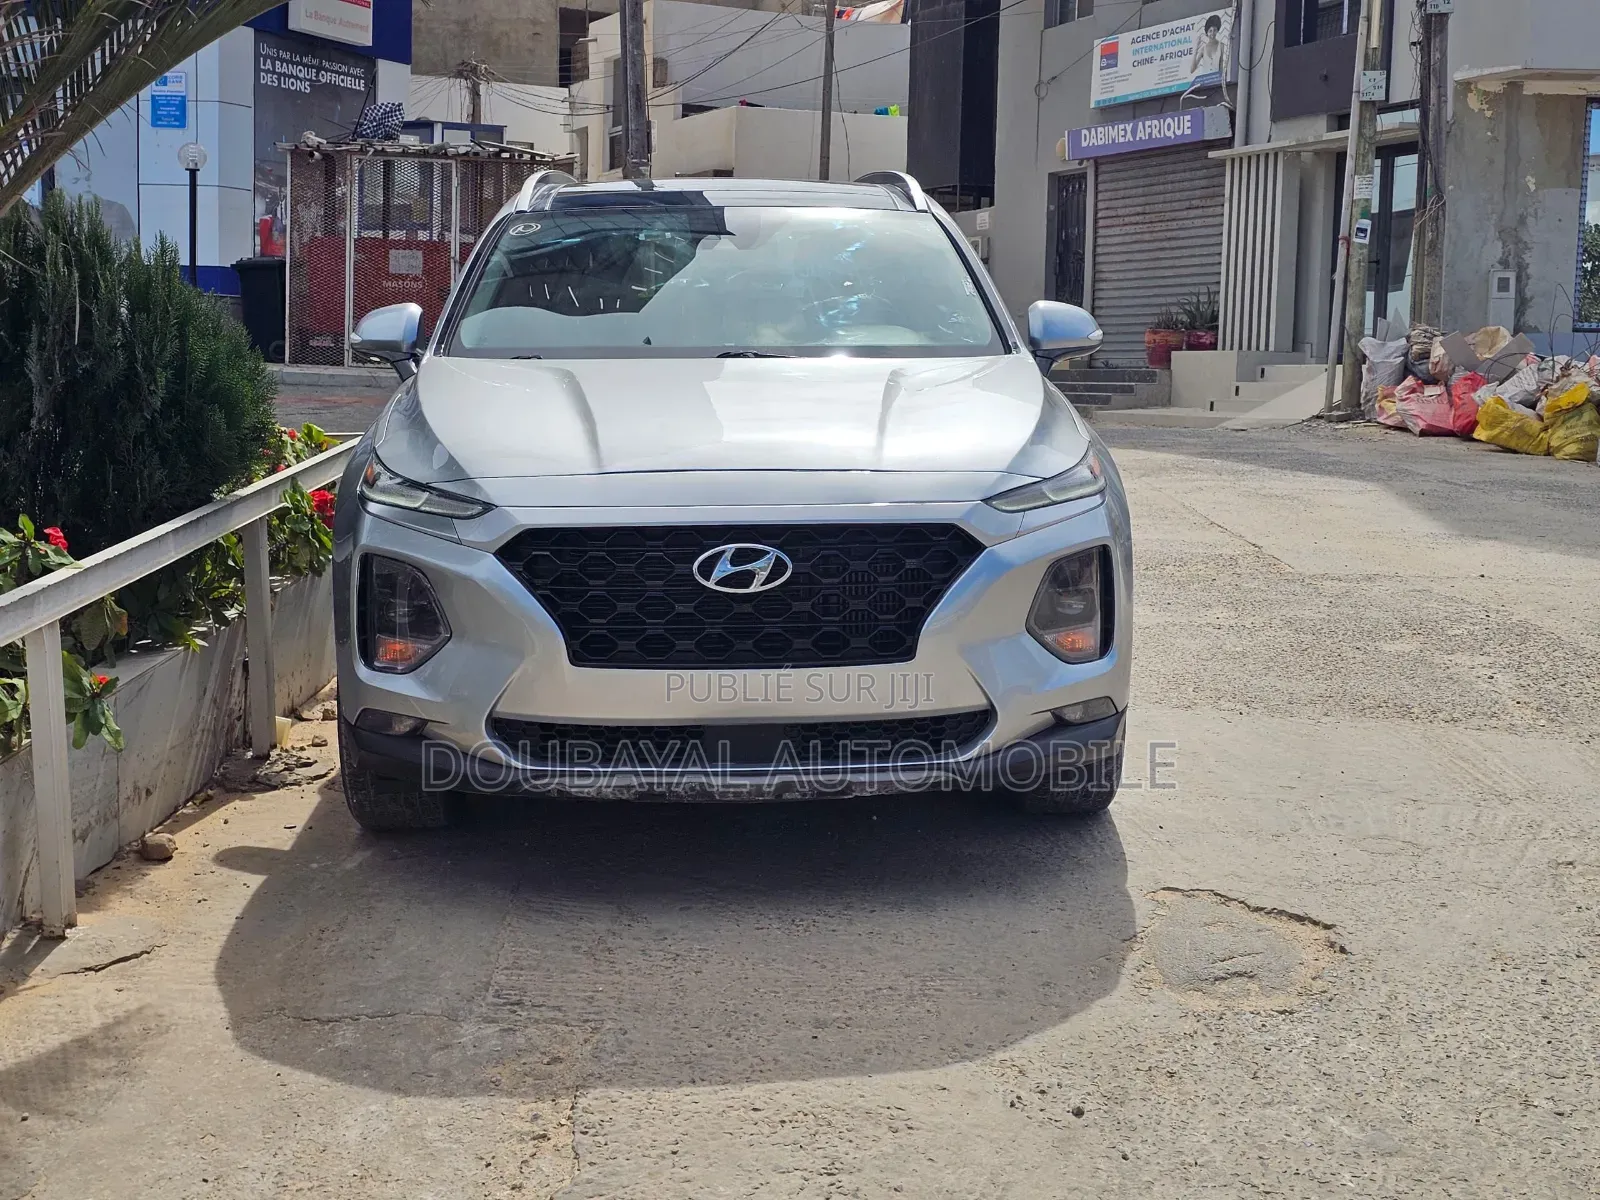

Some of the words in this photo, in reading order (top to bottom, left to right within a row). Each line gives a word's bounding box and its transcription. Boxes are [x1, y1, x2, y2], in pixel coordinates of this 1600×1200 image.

[314, 10, 336, 25] Banque
[1131, 31, 1160, 45] AGENCE
[1162, 23, 1195, 38] D'ACHAT
[1132, 36, 1192, 56] INTERNATIONAL
[1160, 47, 1194, 62] AFRIQUE
[260, 57, 272, 71] LA
[275, 61, 316, 80] BANQUE
[320, 70, 365, 91] OFFICIELLE
[279, 50, 290, 60] PAR
[293, 53, 300, 62] LA
[322, 60, 348, 73] PASSION
[349, 66, 364, 77] AVEC
[260, 72, 278, 87] DES
[281, 76, 310, 93] LIONS
[1081, 122, 1133, 147] DABIMEX
[1136, 115, 1191, 139] AFRIQUE
